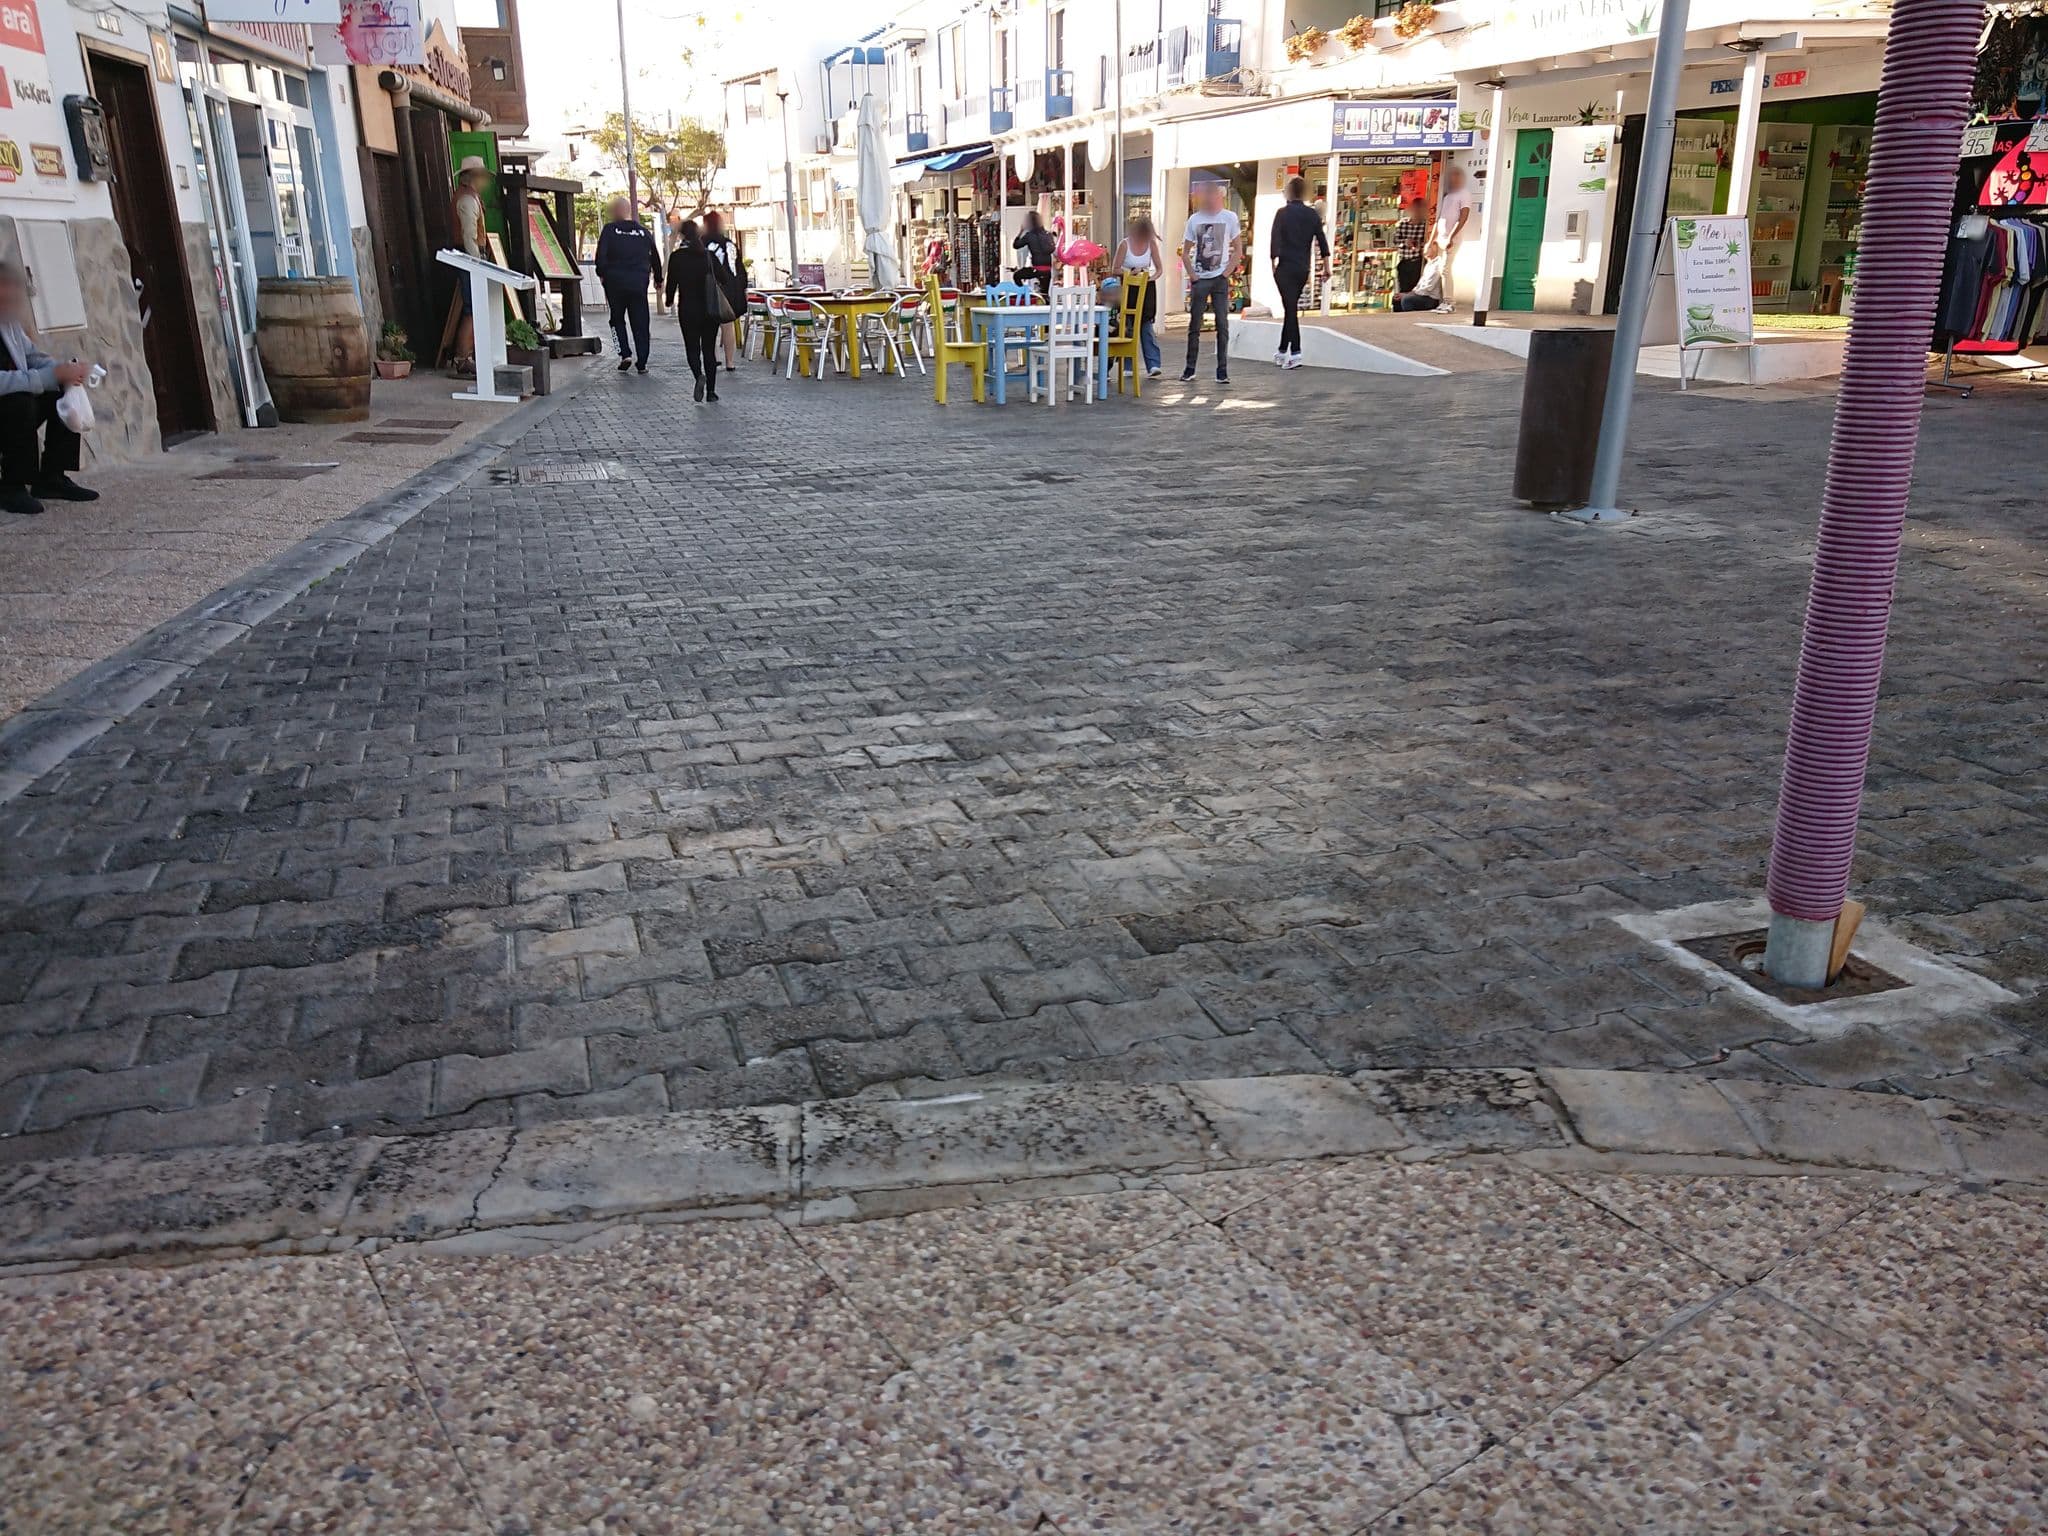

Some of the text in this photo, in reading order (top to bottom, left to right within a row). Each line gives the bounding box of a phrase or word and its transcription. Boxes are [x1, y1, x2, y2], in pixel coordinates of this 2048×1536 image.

[1773, 70, 1807, 88] SHOP
[1507, 106, 1530, 124] Vera
[1532, 113, 1577, 123] Lanzarote
[1363, 155, 1414, 165] REFLEX CAMERAS
